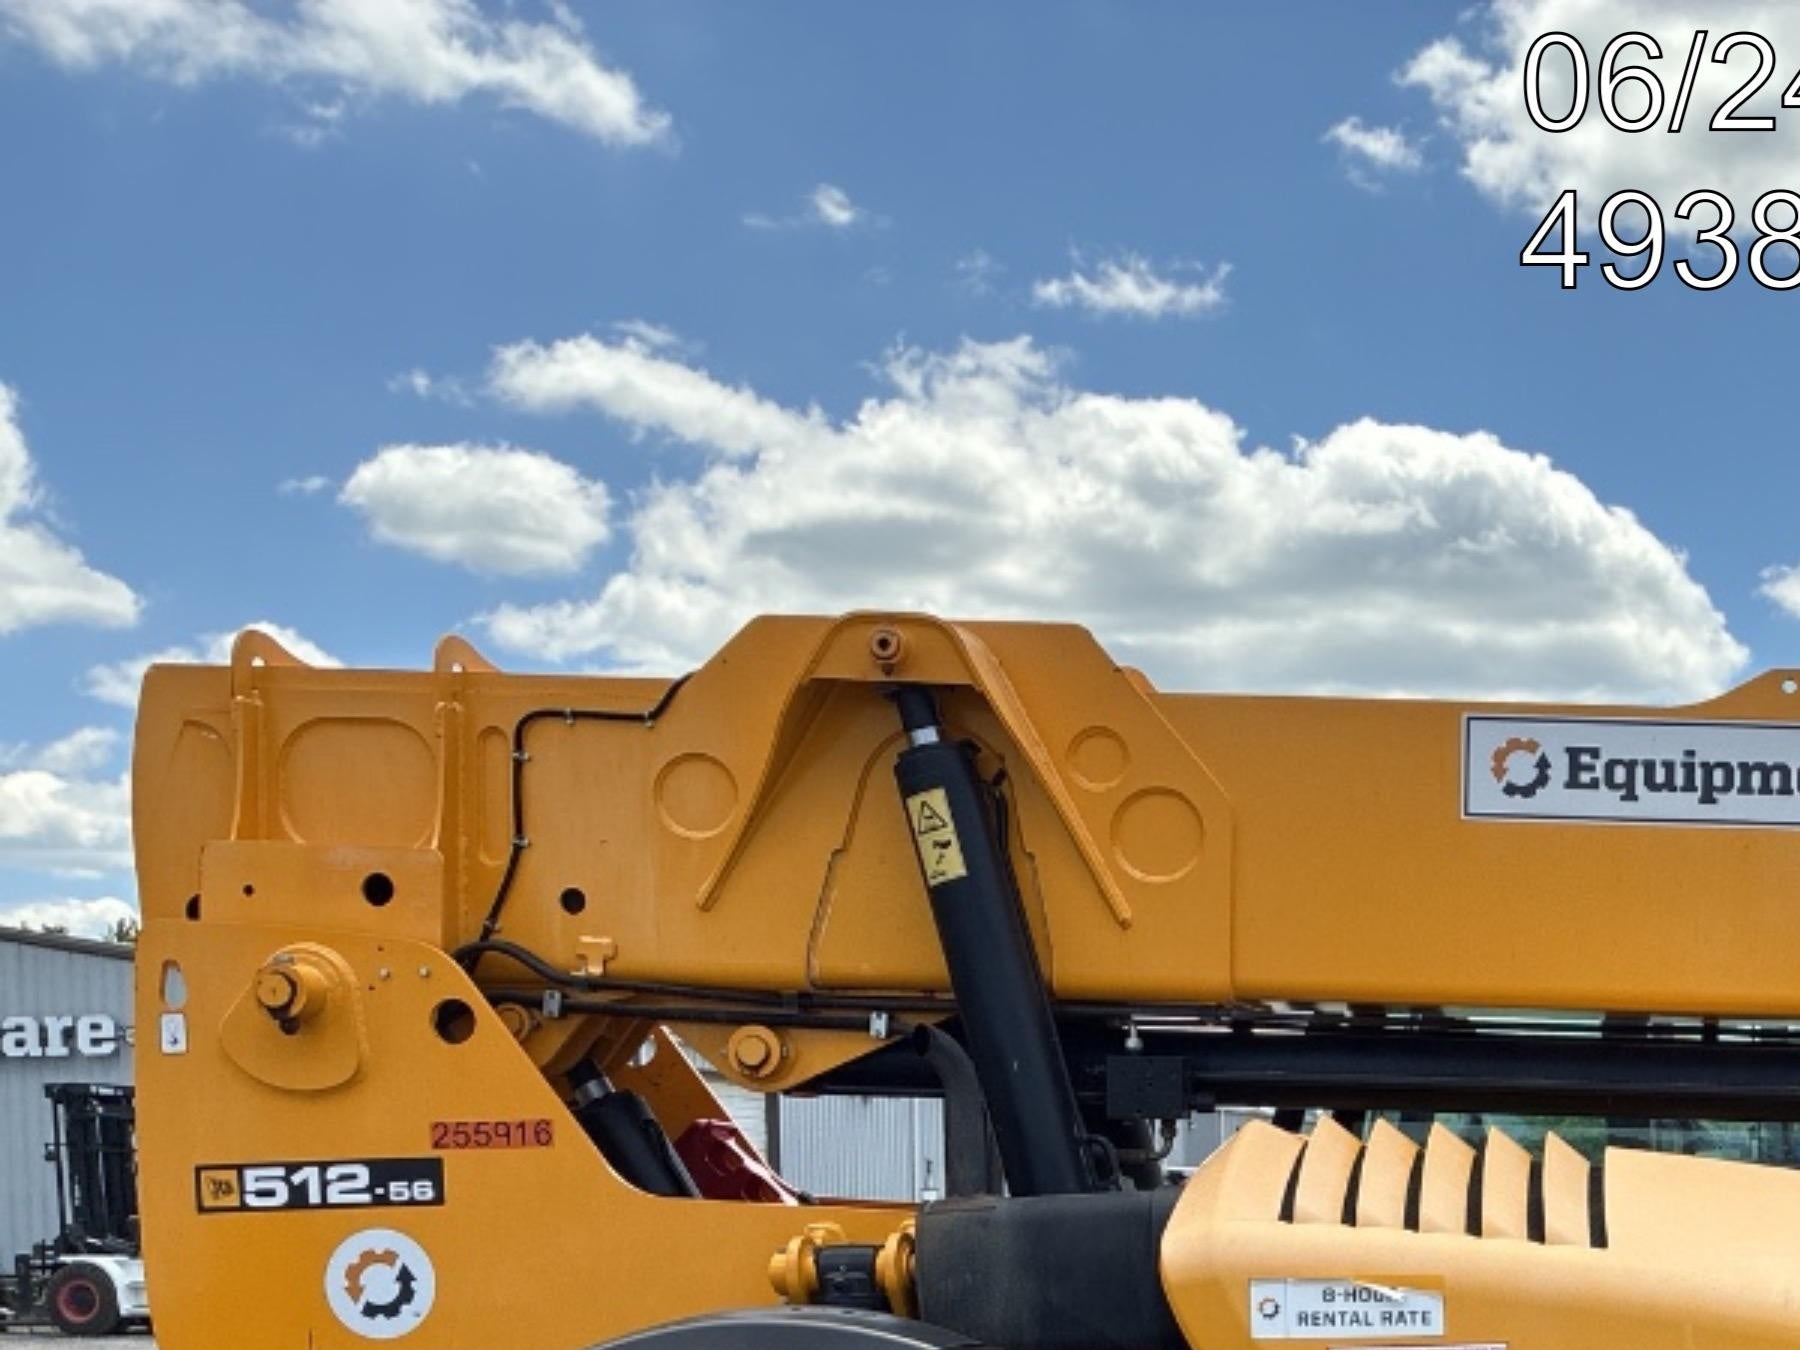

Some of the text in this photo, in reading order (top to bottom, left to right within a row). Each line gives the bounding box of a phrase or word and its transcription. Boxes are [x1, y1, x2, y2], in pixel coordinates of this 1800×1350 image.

[432, 1120, 553, 1149] 255916
[1297, 1310, 1432, 1328] RENTAL RATE
